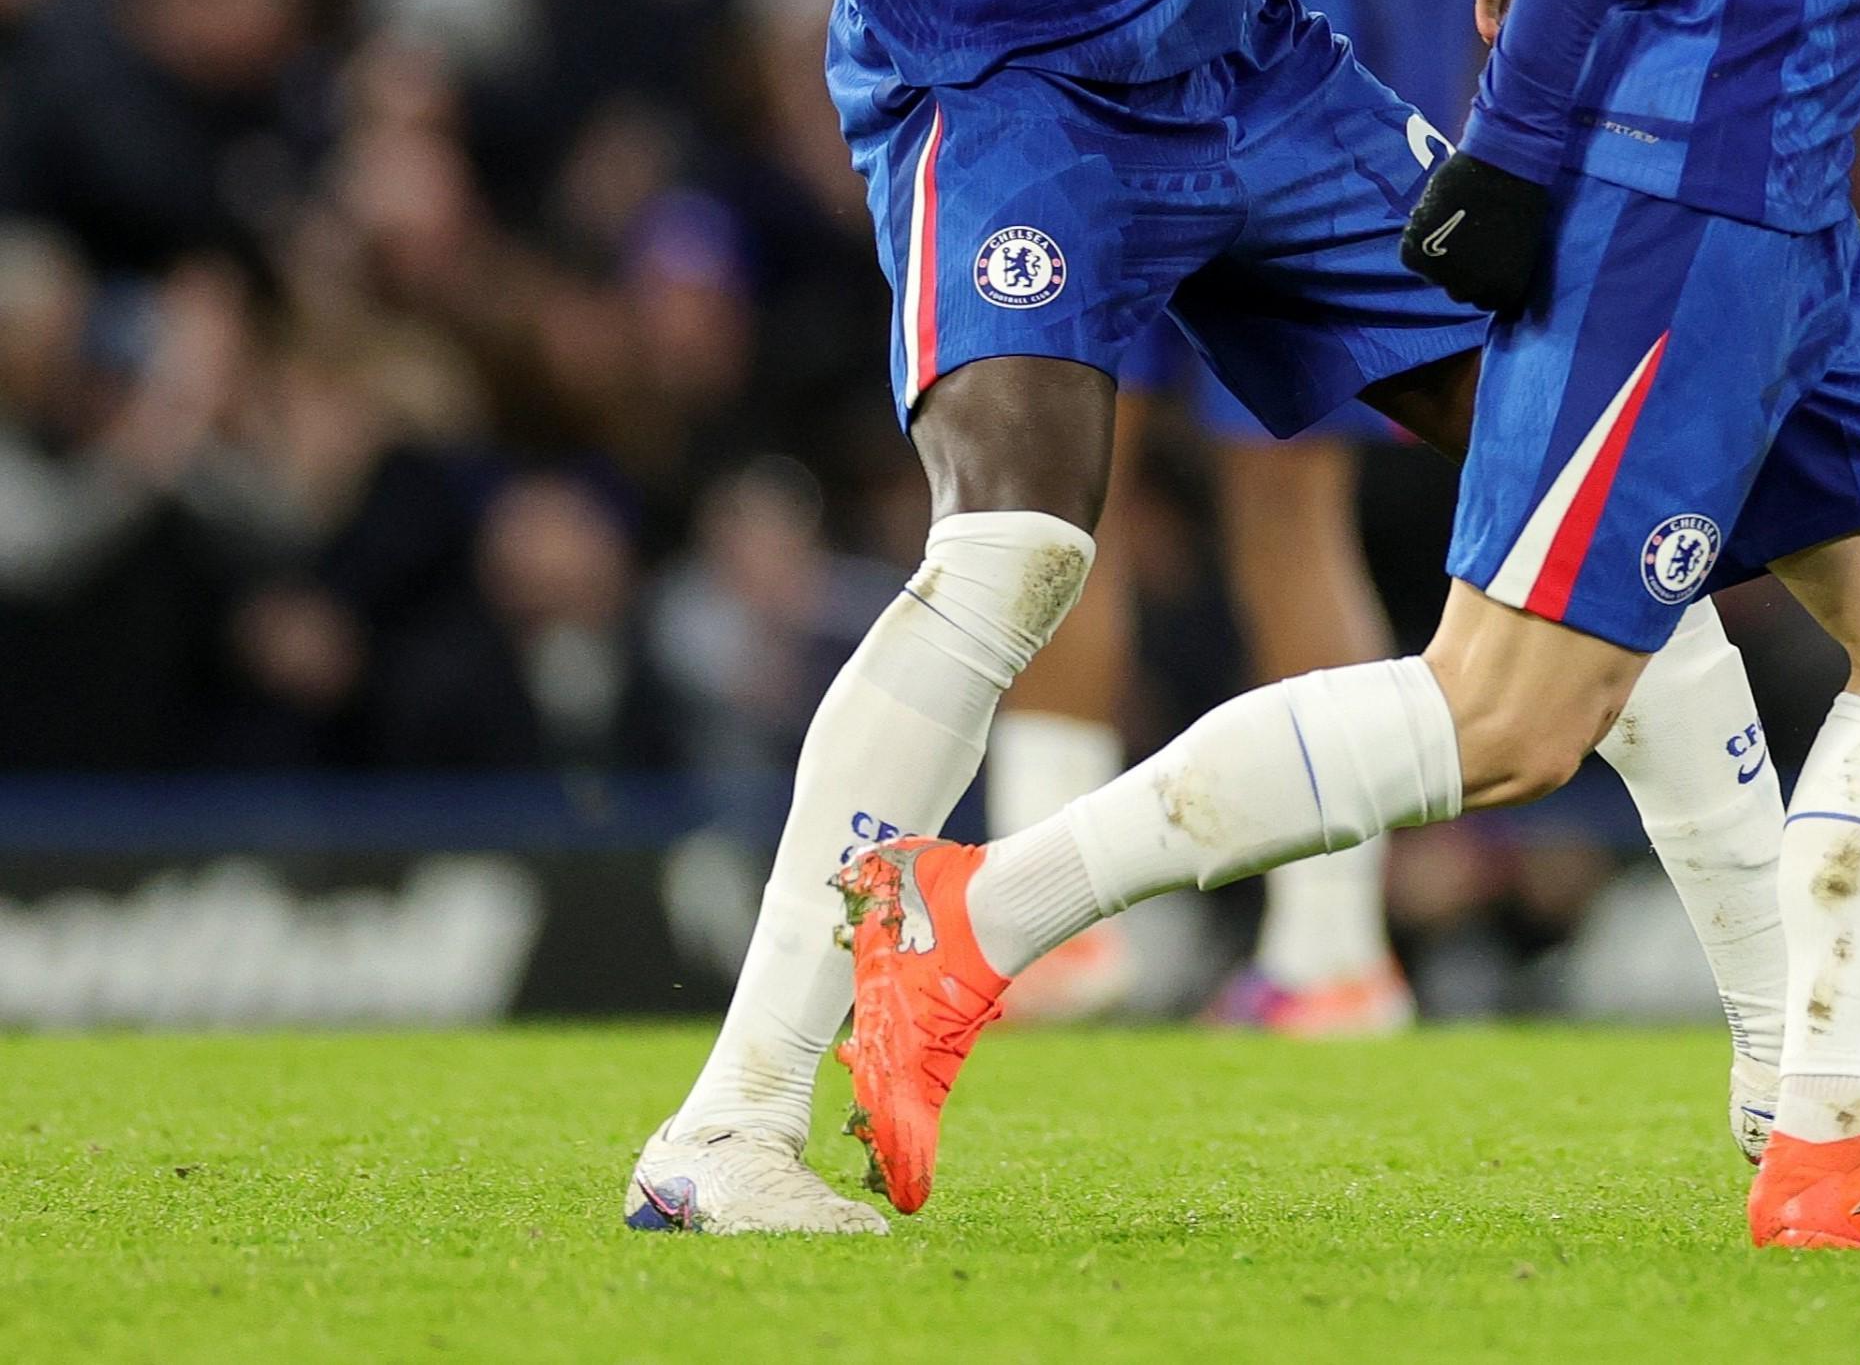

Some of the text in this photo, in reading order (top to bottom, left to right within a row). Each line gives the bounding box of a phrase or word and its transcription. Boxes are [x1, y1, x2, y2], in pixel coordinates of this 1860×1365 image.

[989, 229, 1049, 250] CHELSEA
[1669, 518, 1717, 543] CHELSEA
[851, 811, 919, 843] CF
